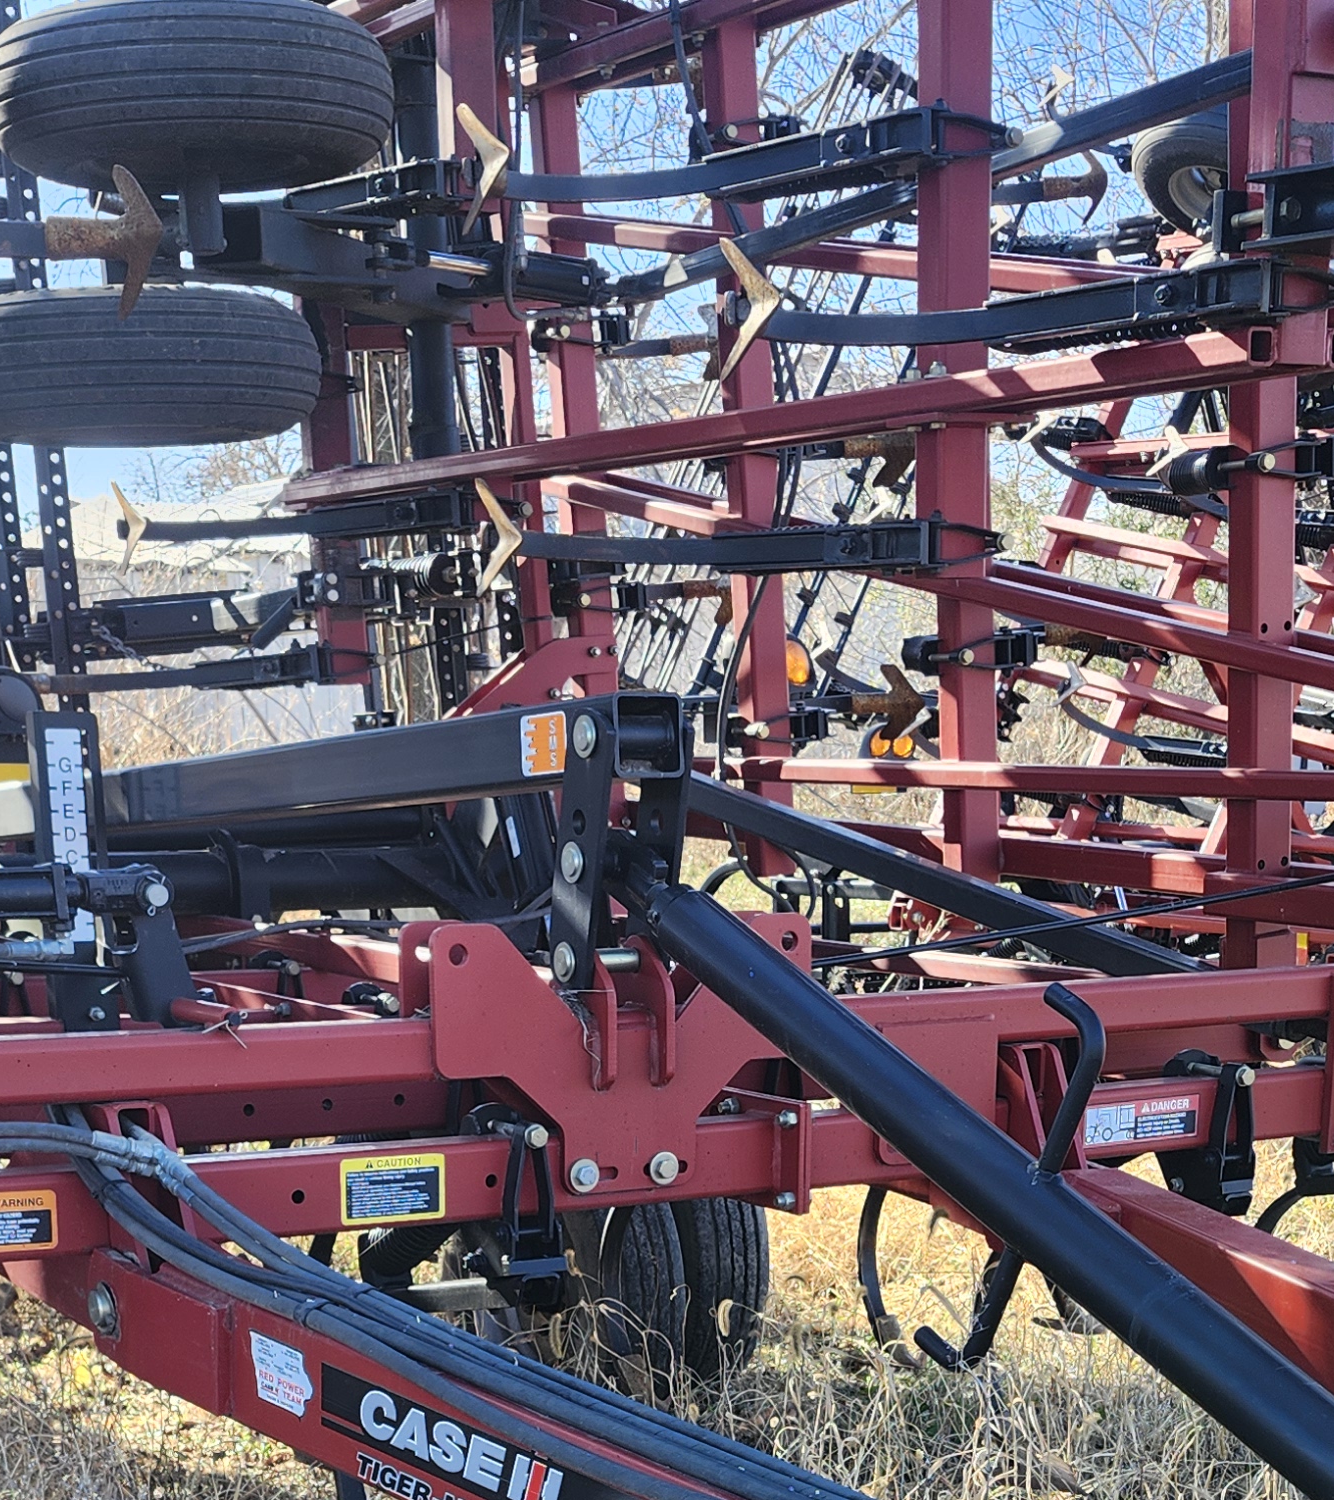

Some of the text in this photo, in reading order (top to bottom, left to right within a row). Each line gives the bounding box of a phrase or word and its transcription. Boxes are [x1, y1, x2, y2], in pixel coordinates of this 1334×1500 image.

[58, 757, 72, 773] G
[62, 781, 72, 796] F
[63, 804, 75, 819] E
[65, 827, 76, 842] D
[65, 850, 78, 866] C
[1151, 1098, 1190, 1112] DANGER
[376, 1157, 422, 1168] CAUTION
[259, 1369, 274, 1383] RED
[277, 1377, 305, 1397] POWER
[359, 1389, 507, 1493] CASE
